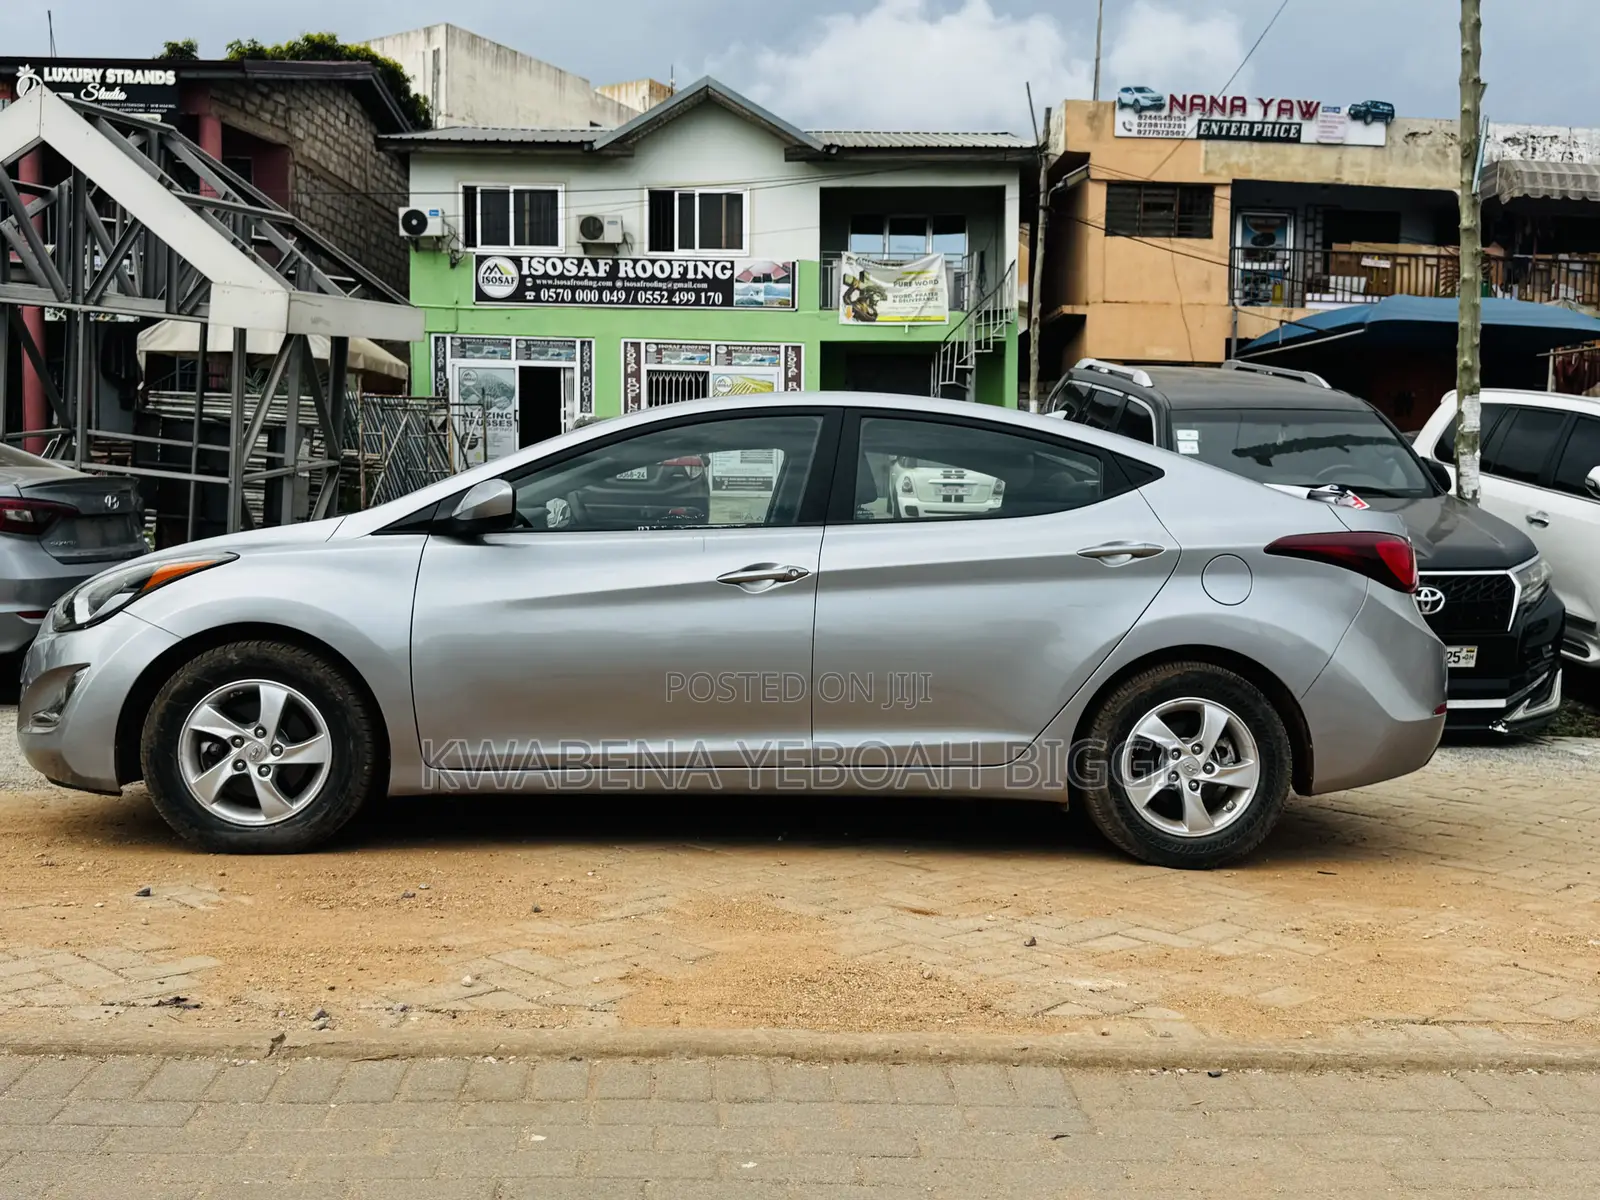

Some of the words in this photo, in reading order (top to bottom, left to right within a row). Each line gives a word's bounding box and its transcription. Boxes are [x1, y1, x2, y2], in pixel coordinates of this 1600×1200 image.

[43, 66, 104, 83] LUXURY
[105, 69, 176, 85] STRANDS
[1168, 93, 1247, 116] NANA
[1256, 97, 1321, 120] YAW
[520, 257, 613, 277] ISOSAF
[617, 258, 733, 280] ROOFING
[481, 275, 516, 285] ISOSAF
[536, 278, 613, 288] www.isosafroofing.com
[624, 279, 708, 290] isosafroofing@gmail.com
[540, 288, 572, 302] 0570
[575, 289, 599, 302] 000
[602, 290, 626, 303] 049
[628, 290, 635, 303] /
[637, 290, 669, 304] 0552
[672, 291, 696, 305] 499
[700, 292, 723, 305] 170
[627, 377, 640, 412] ROOFIN
